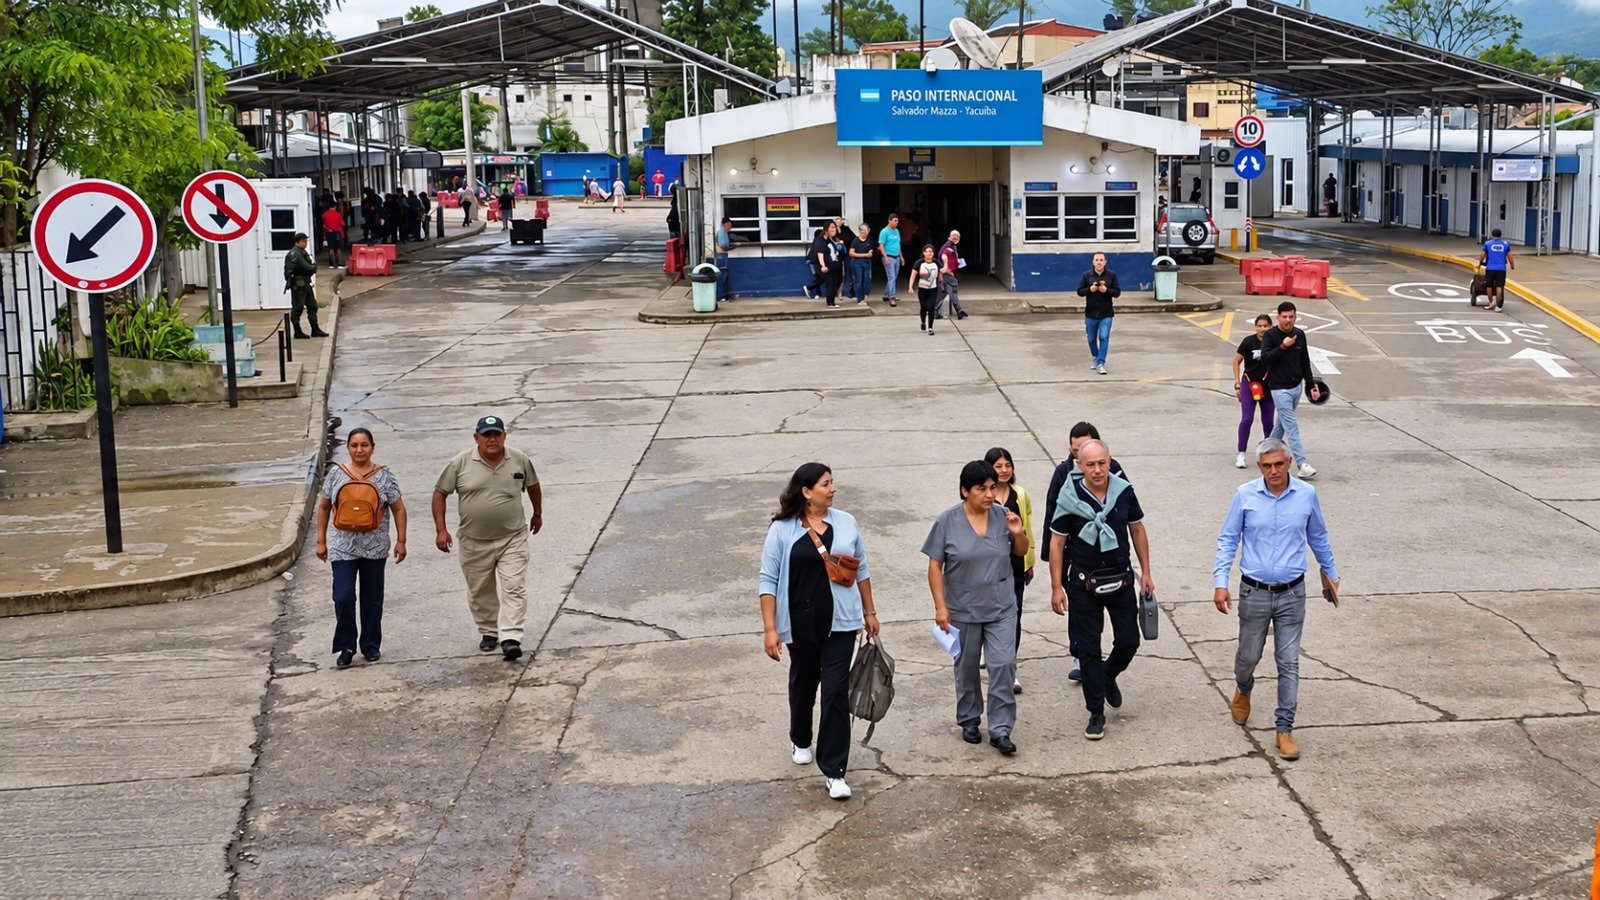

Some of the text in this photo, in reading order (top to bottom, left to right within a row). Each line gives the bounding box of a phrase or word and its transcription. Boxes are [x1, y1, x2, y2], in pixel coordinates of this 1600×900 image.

[891, 89, 1018, 102] PASO INTERNACIONAL
[891, 105, 928, 116] Salvador
[931, 106, 957, 116] Mazza
[1241, 122, 1258, 135] 10
[1424, 325, 1553, 346] BUS
